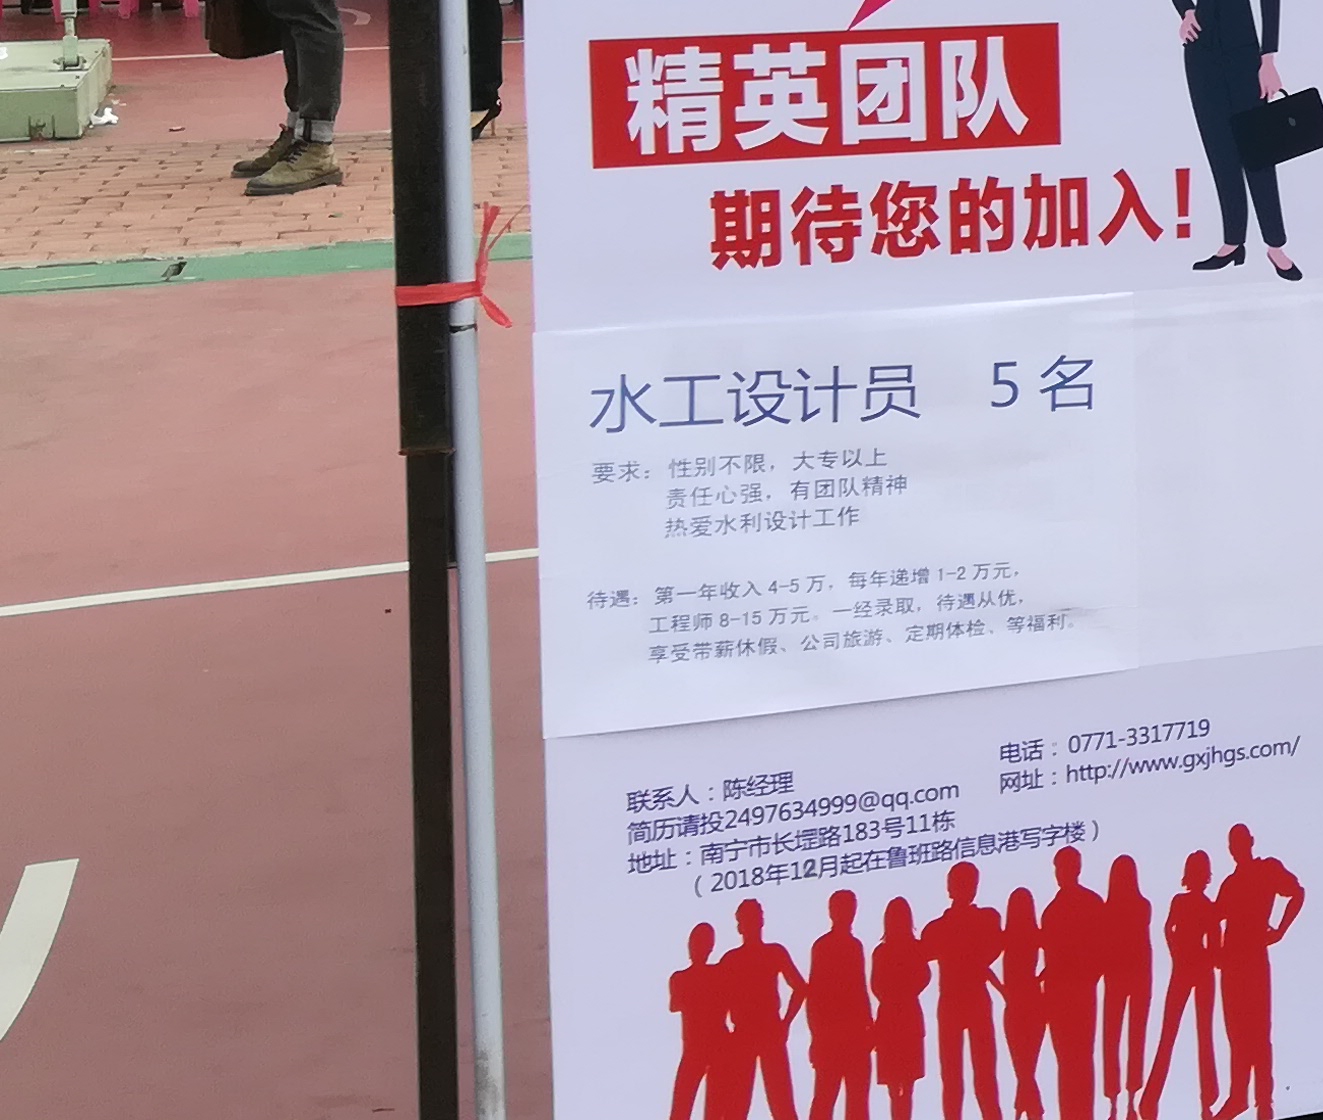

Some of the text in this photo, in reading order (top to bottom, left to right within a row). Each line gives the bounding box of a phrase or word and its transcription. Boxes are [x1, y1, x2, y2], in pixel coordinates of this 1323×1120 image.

[625, 36, 1030, 155] 精英团队
[589, 364, 921, 434] 水工设计员
[664, 505, 860, 539] 热爱水利设计工作
